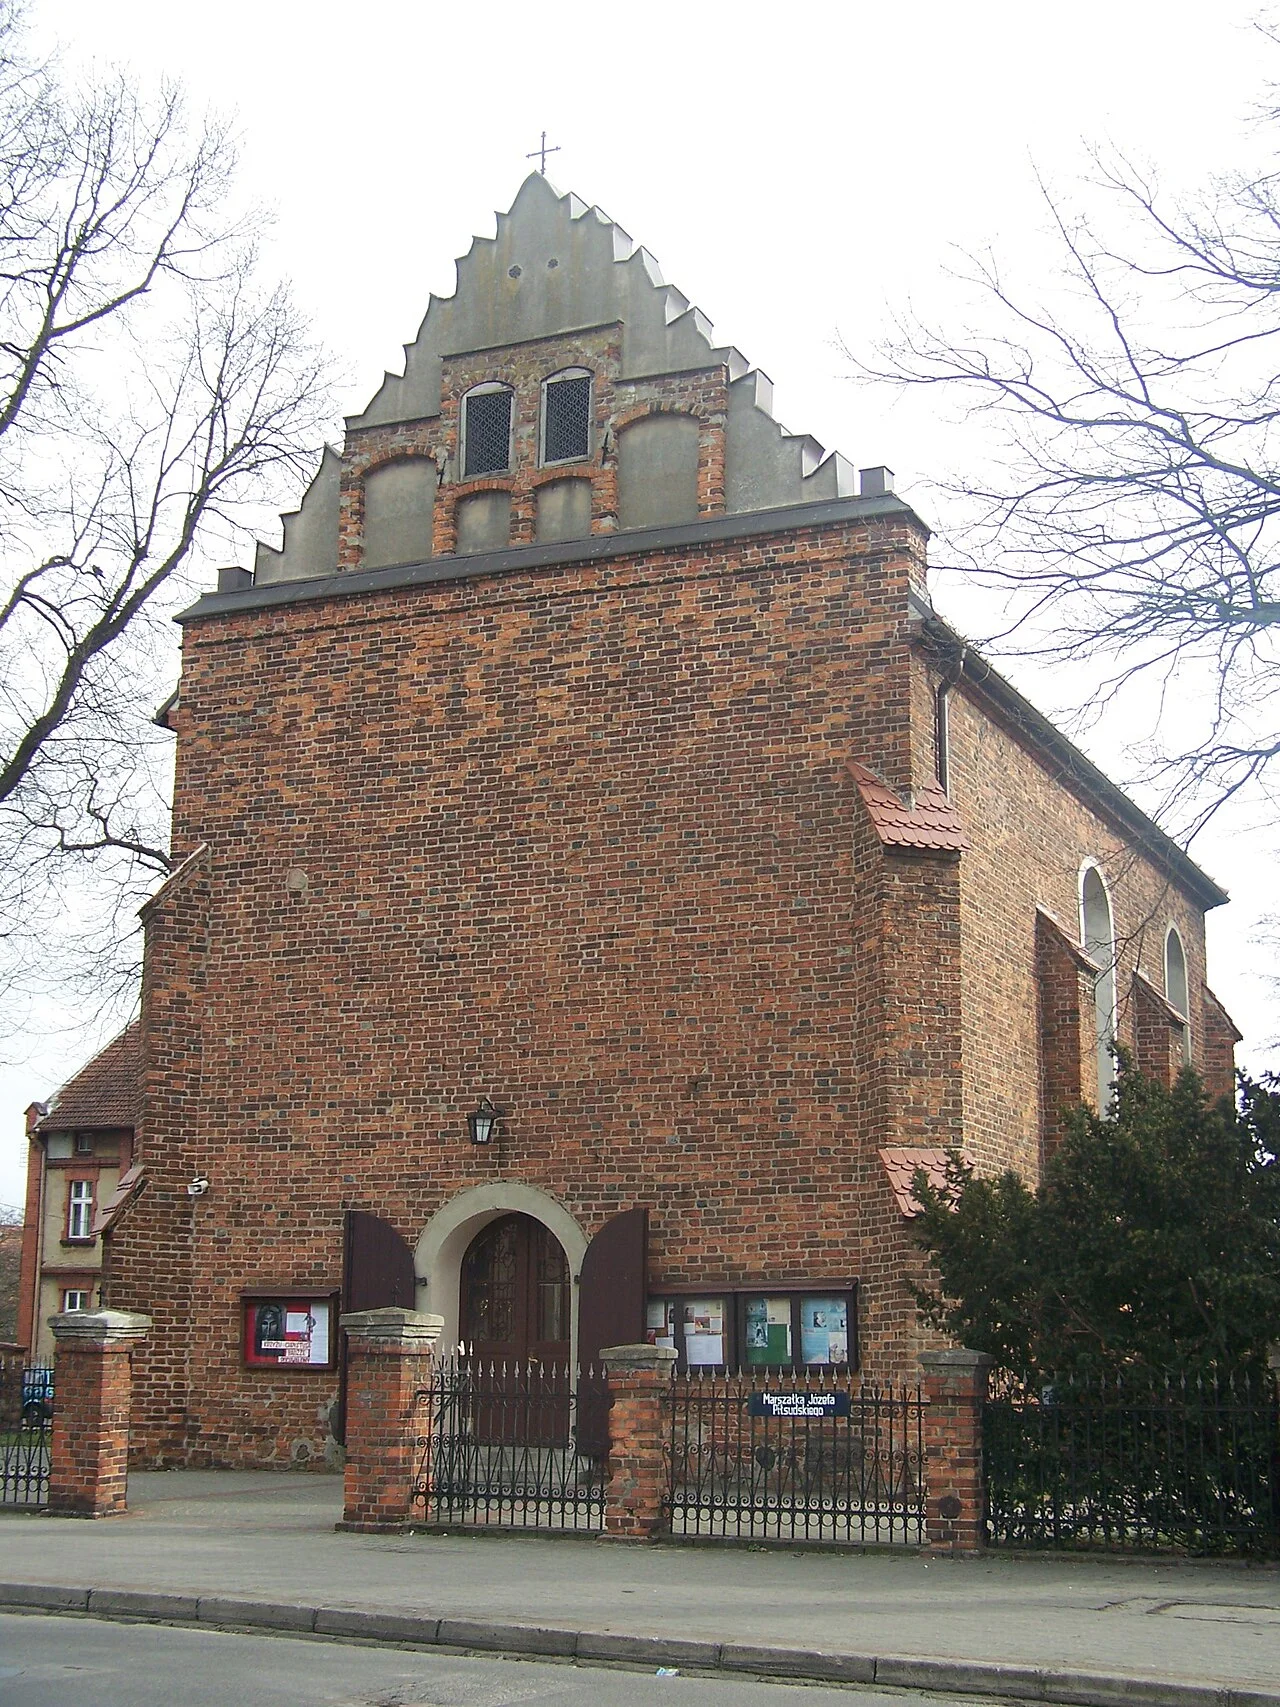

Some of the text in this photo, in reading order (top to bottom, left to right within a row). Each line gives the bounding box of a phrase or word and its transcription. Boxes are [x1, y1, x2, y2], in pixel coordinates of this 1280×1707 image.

[762, 1393, 836, 1405] Marszałka Józefa
[772, 1403, 825, 1417] Piłsudskiego
